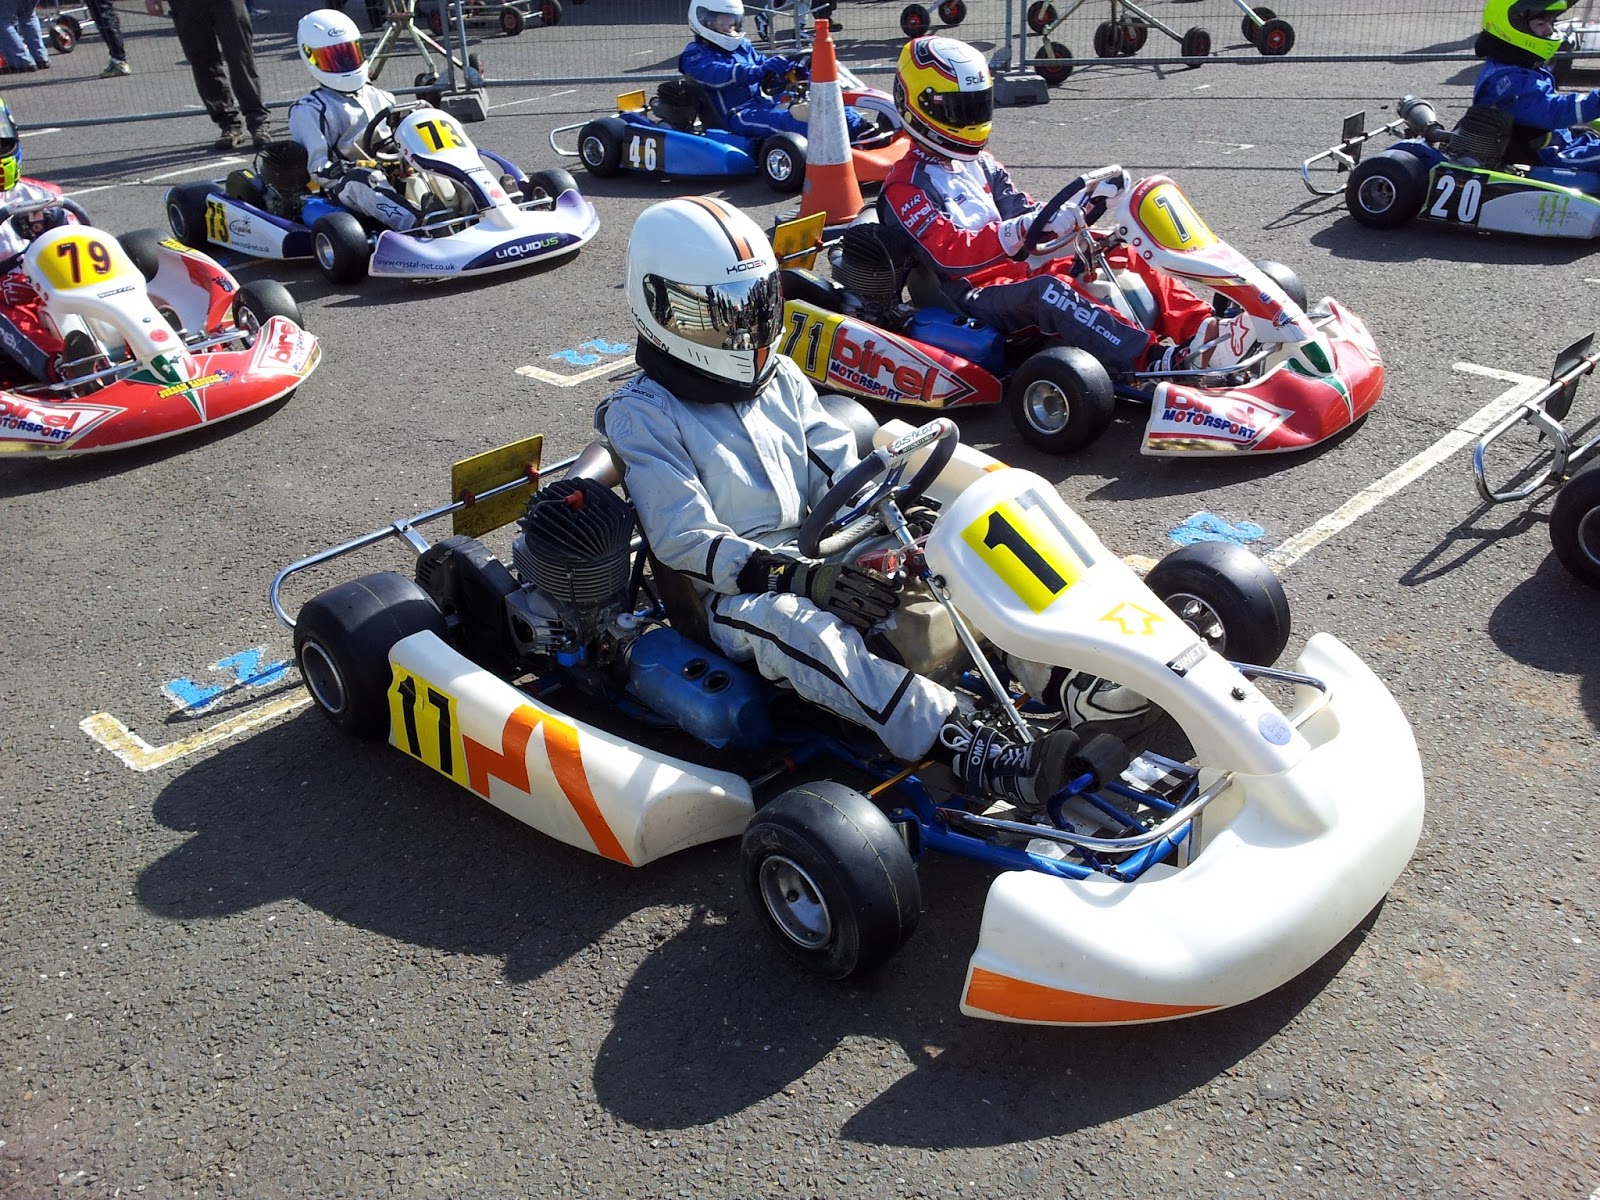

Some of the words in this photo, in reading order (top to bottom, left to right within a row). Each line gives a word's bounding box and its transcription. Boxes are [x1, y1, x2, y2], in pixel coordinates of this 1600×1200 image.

[417, 119, 467, 150] 73
[629, 136, 657, 171] 46
[903, 203, 932, 229] birel
[1430, 175, 1482, 223] 20
[57, 240, 112, 283] 79
[377, 258, 455, 271] www.crystal-net.co.uk
[783, 311, 825, 372] 71
[829, 360, 903, 402] MOTORSPORT
[831, 327, 941, 402] birel
[0, 416, 72, 441] TORSPORT
[1162, 409, 1256, 440] MOTORSPORT
[983, 488, 1096, 595] 17
[398, 675, 454, 776] 17
[971, 739, 987, 766] OMP
